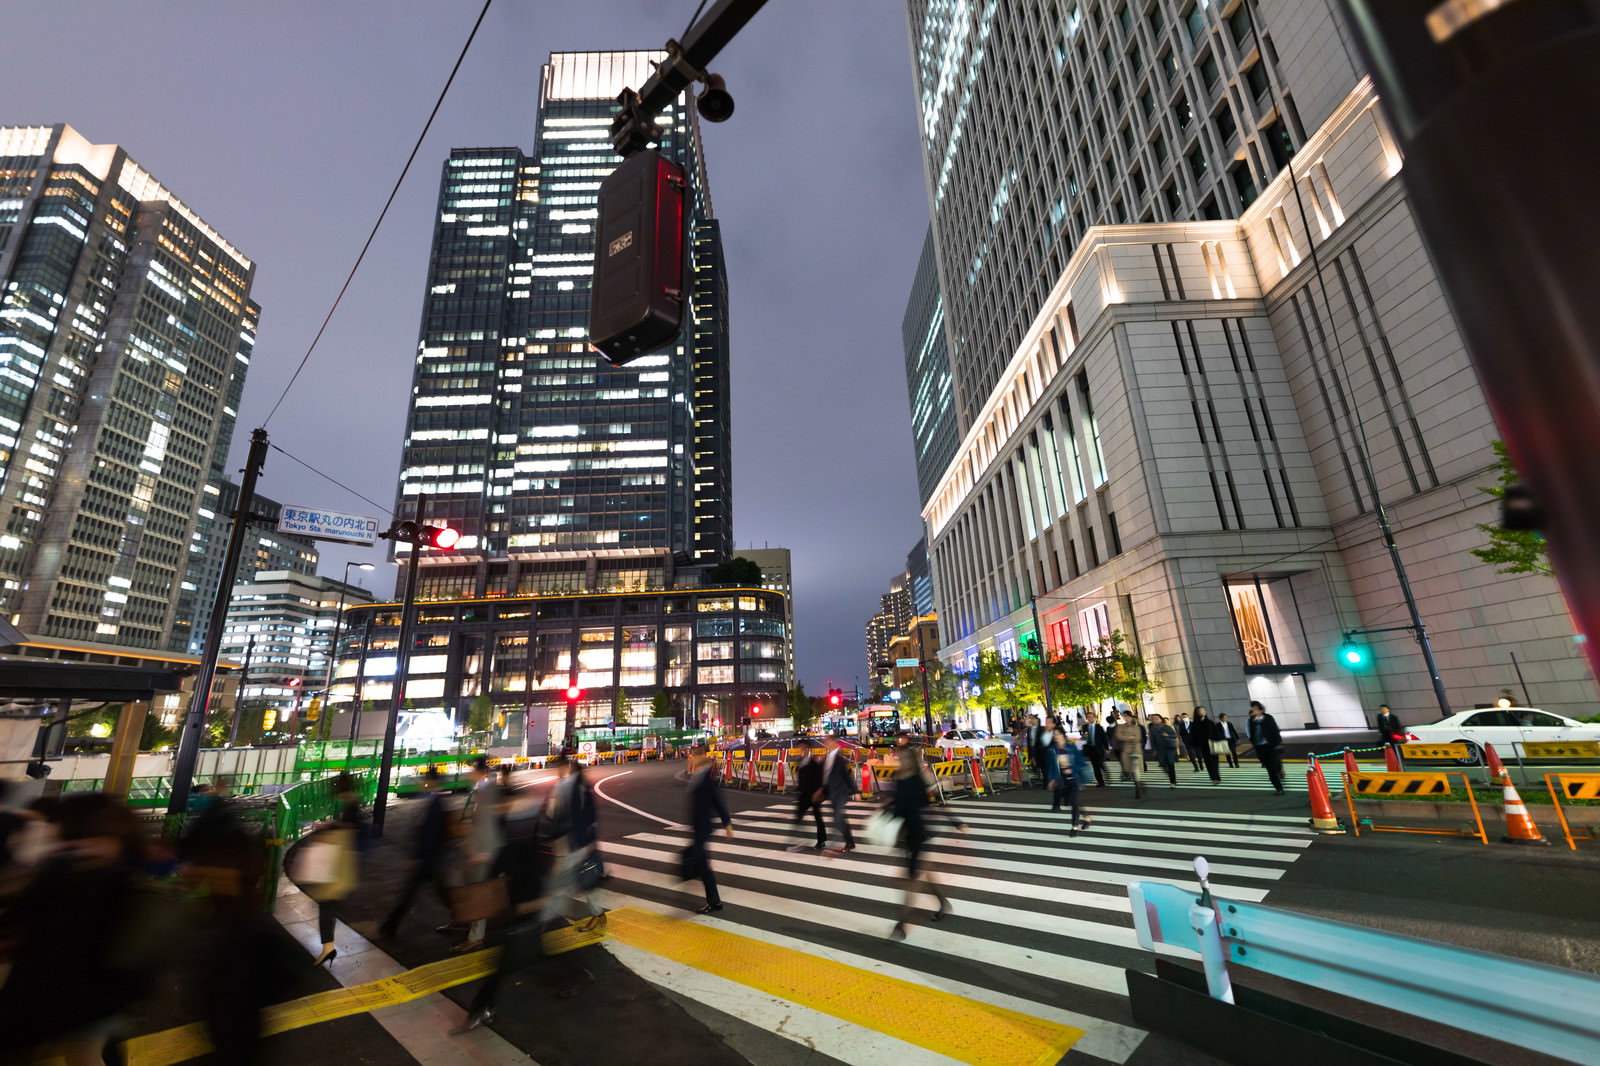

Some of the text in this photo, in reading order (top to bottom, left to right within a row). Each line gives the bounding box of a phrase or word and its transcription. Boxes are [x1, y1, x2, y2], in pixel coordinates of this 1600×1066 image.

[284, 509, 376, 531] 東京駅丸の内北口
[285, 521, 306, 531] Tokyo
[325, 528, 365, 538] marunouchi
